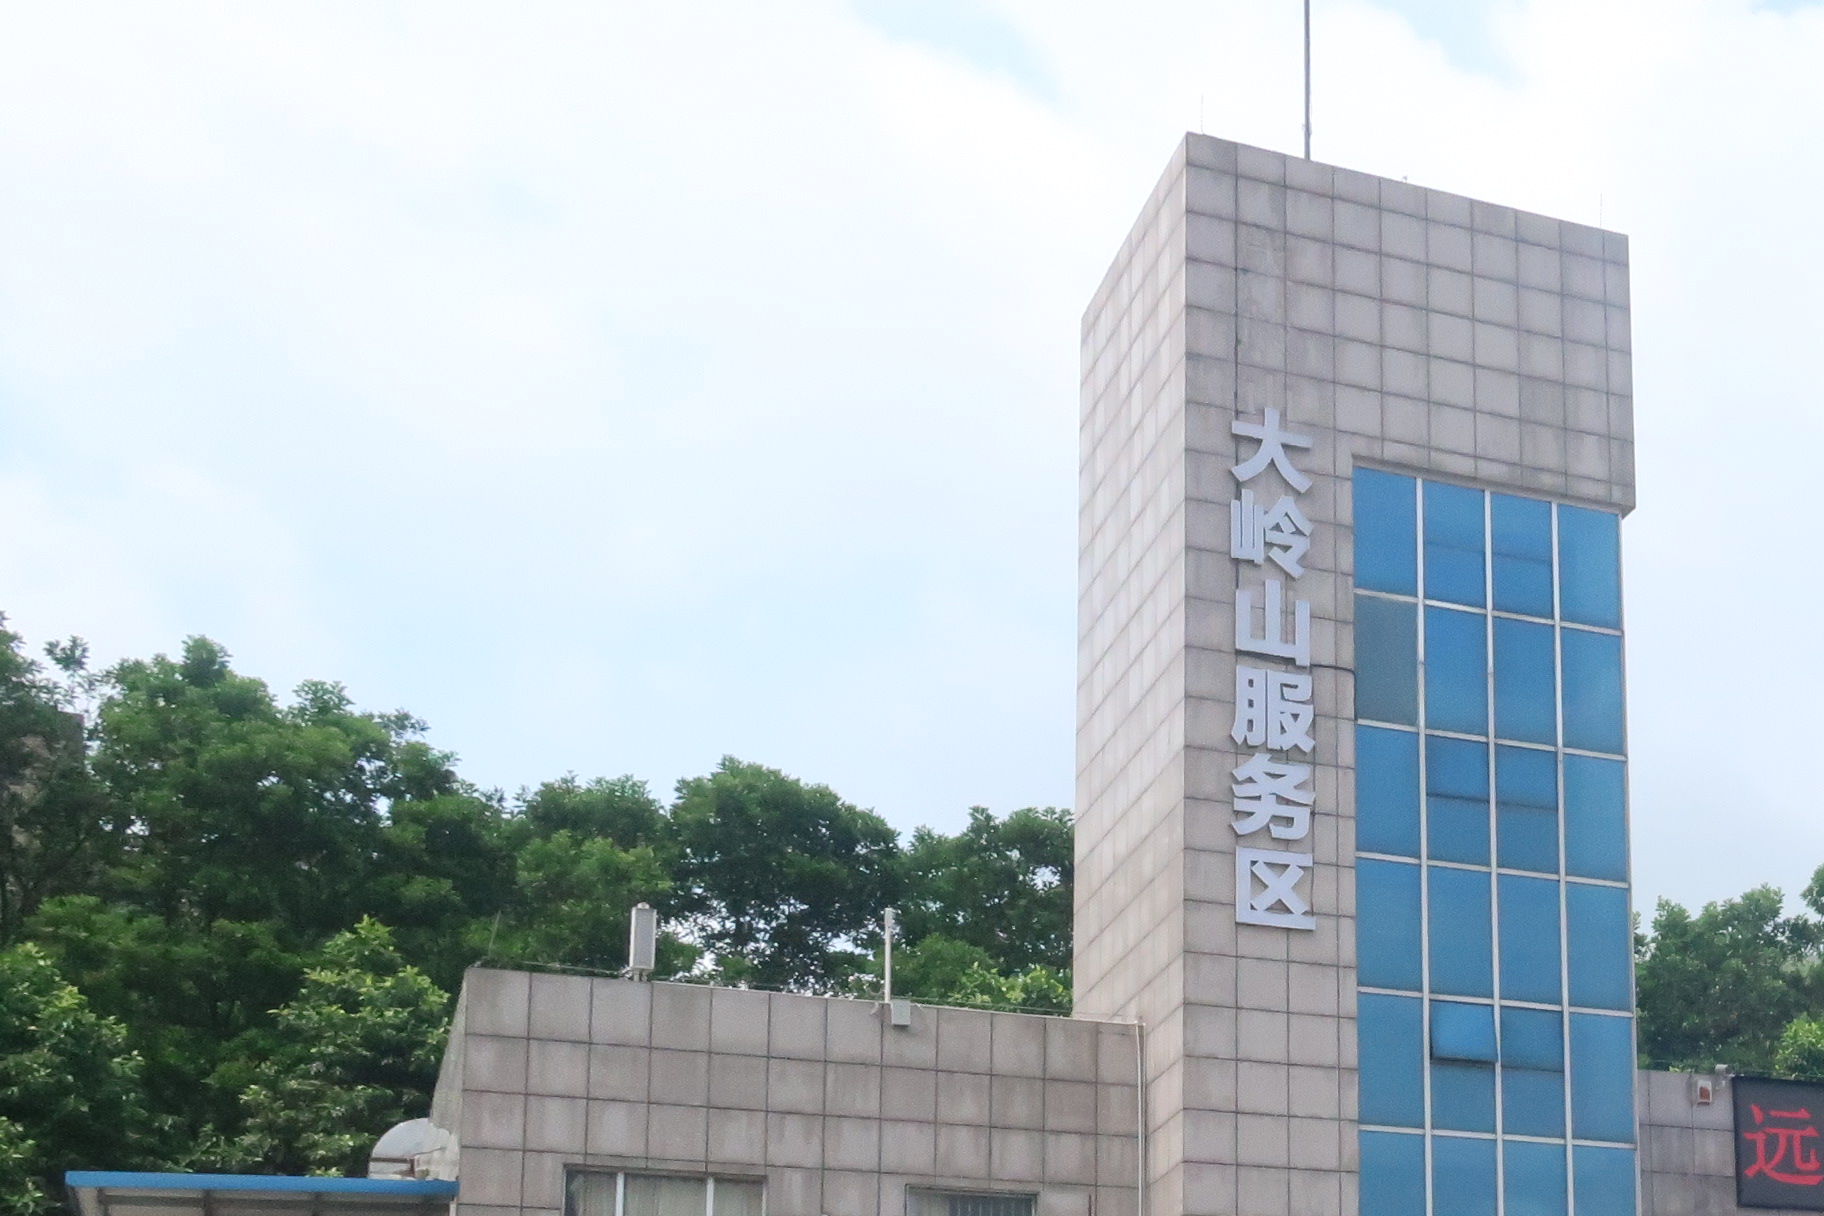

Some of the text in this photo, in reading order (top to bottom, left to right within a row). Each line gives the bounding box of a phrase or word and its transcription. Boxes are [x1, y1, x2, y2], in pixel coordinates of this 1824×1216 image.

[1230, 406, 1317, 932] 大岭山服务区
